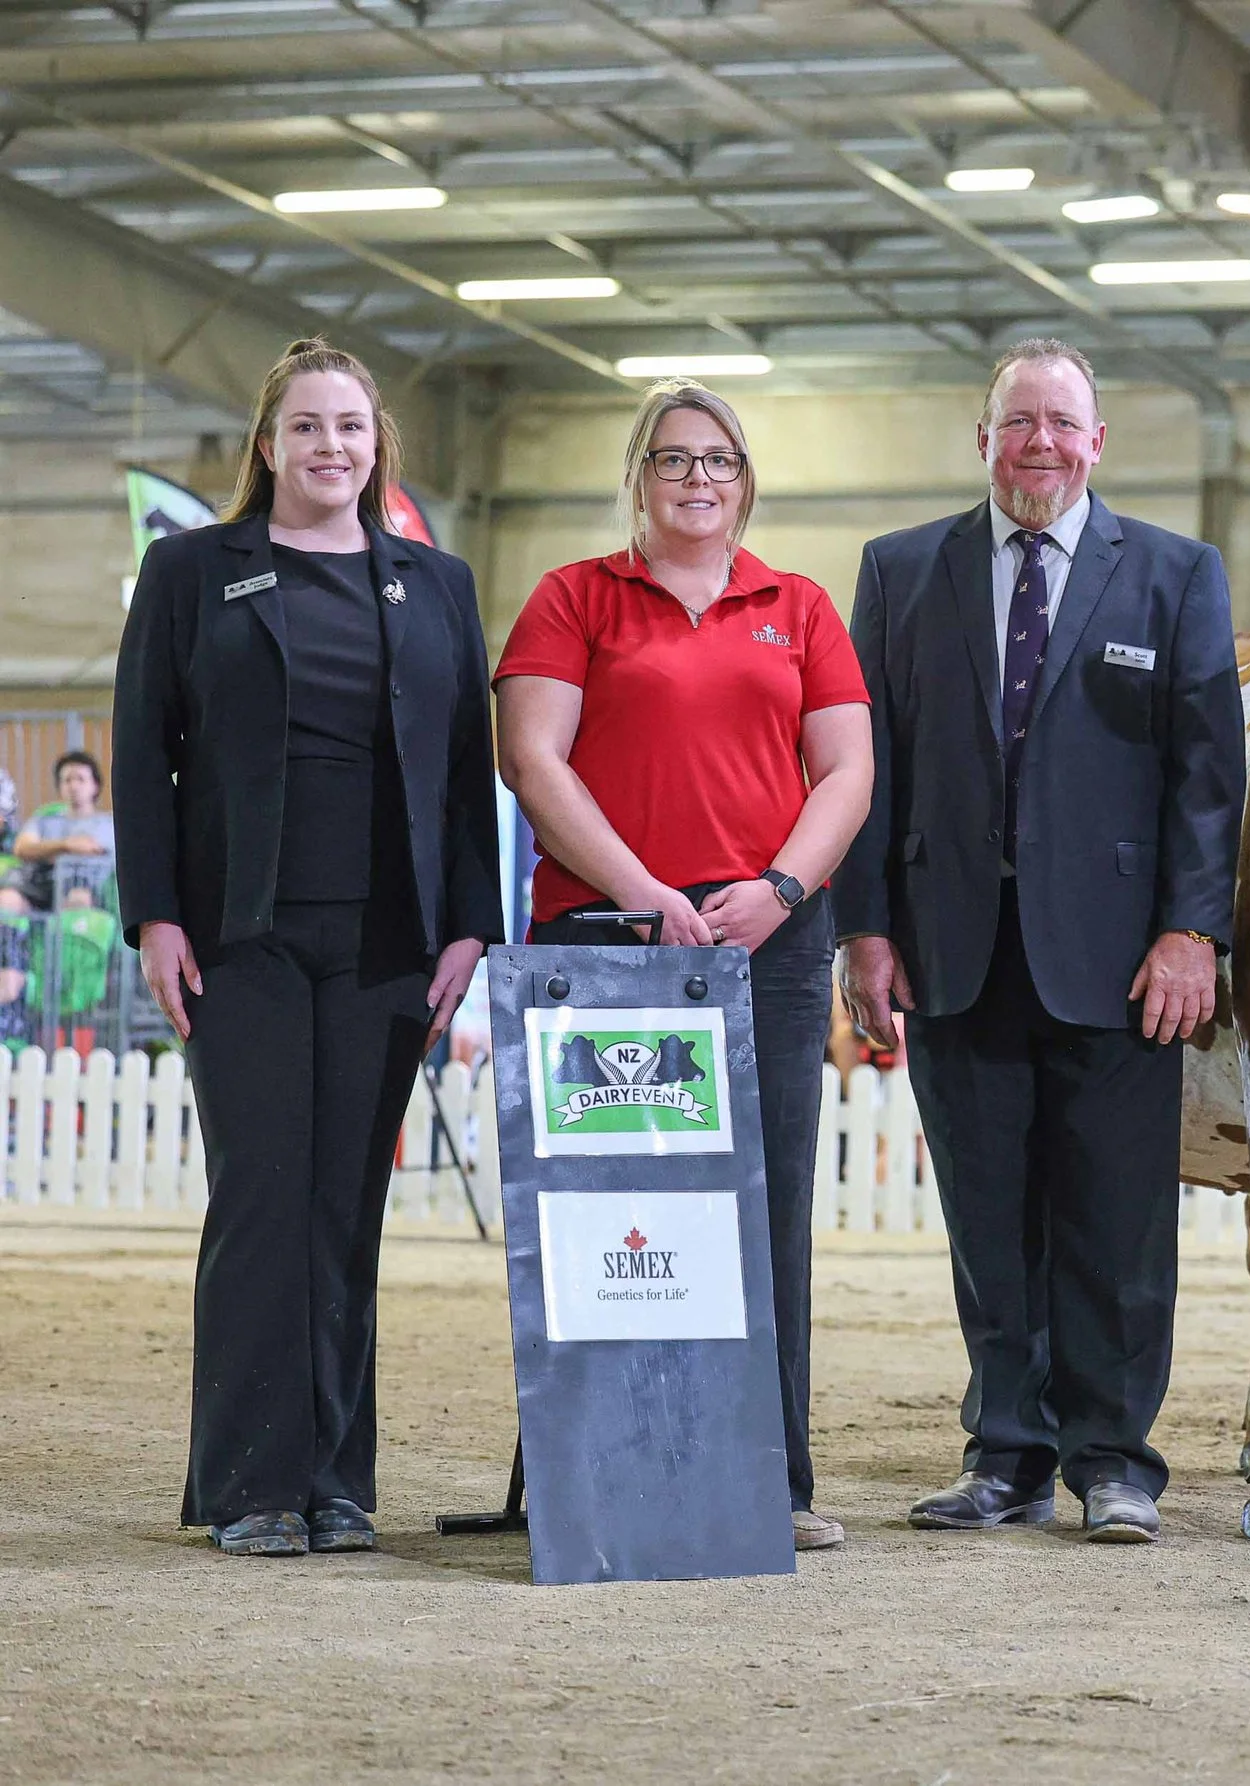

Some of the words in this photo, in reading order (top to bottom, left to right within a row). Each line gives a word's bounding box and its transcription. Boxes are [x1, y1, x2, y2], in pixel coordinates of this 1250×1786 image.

[751, 630, 791, 646] SEMEX
[618, 1049, 641, 1063] NZ
[597, 1288, 644, 1301] Genetics
[646, 1288, 662, 1301] for
